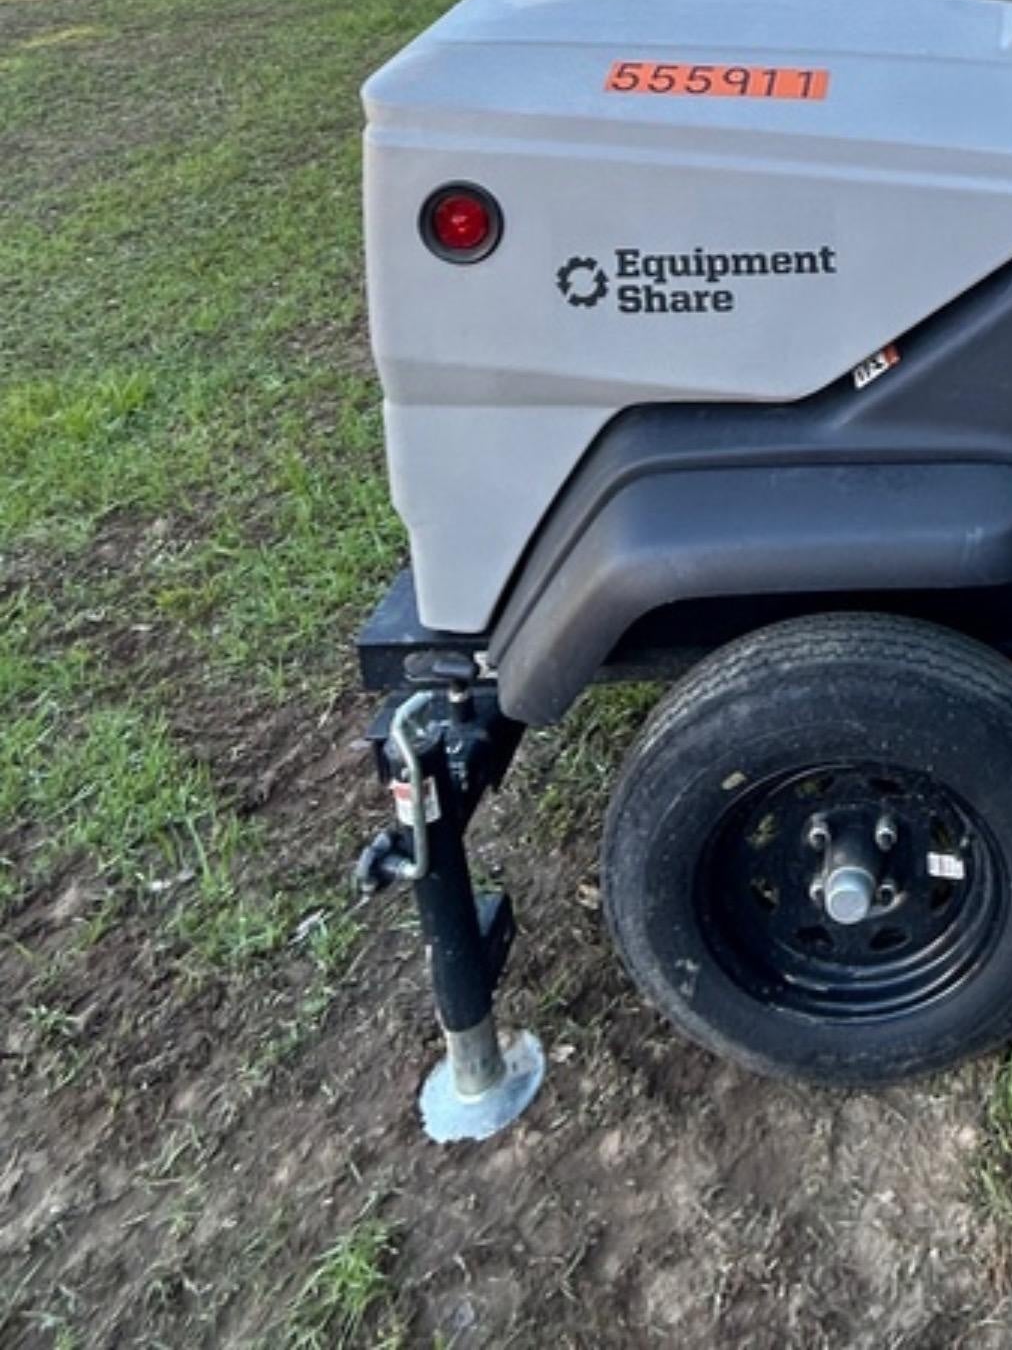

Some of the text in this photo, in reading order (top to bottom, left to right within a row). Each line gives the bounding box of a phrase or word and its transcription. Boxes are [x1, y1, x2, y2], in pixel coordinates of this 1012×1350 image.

[611, 62, 814, 99] 555911
[615, 246, 837, 284] Equipment
[617, 284, 735, 313] Share
